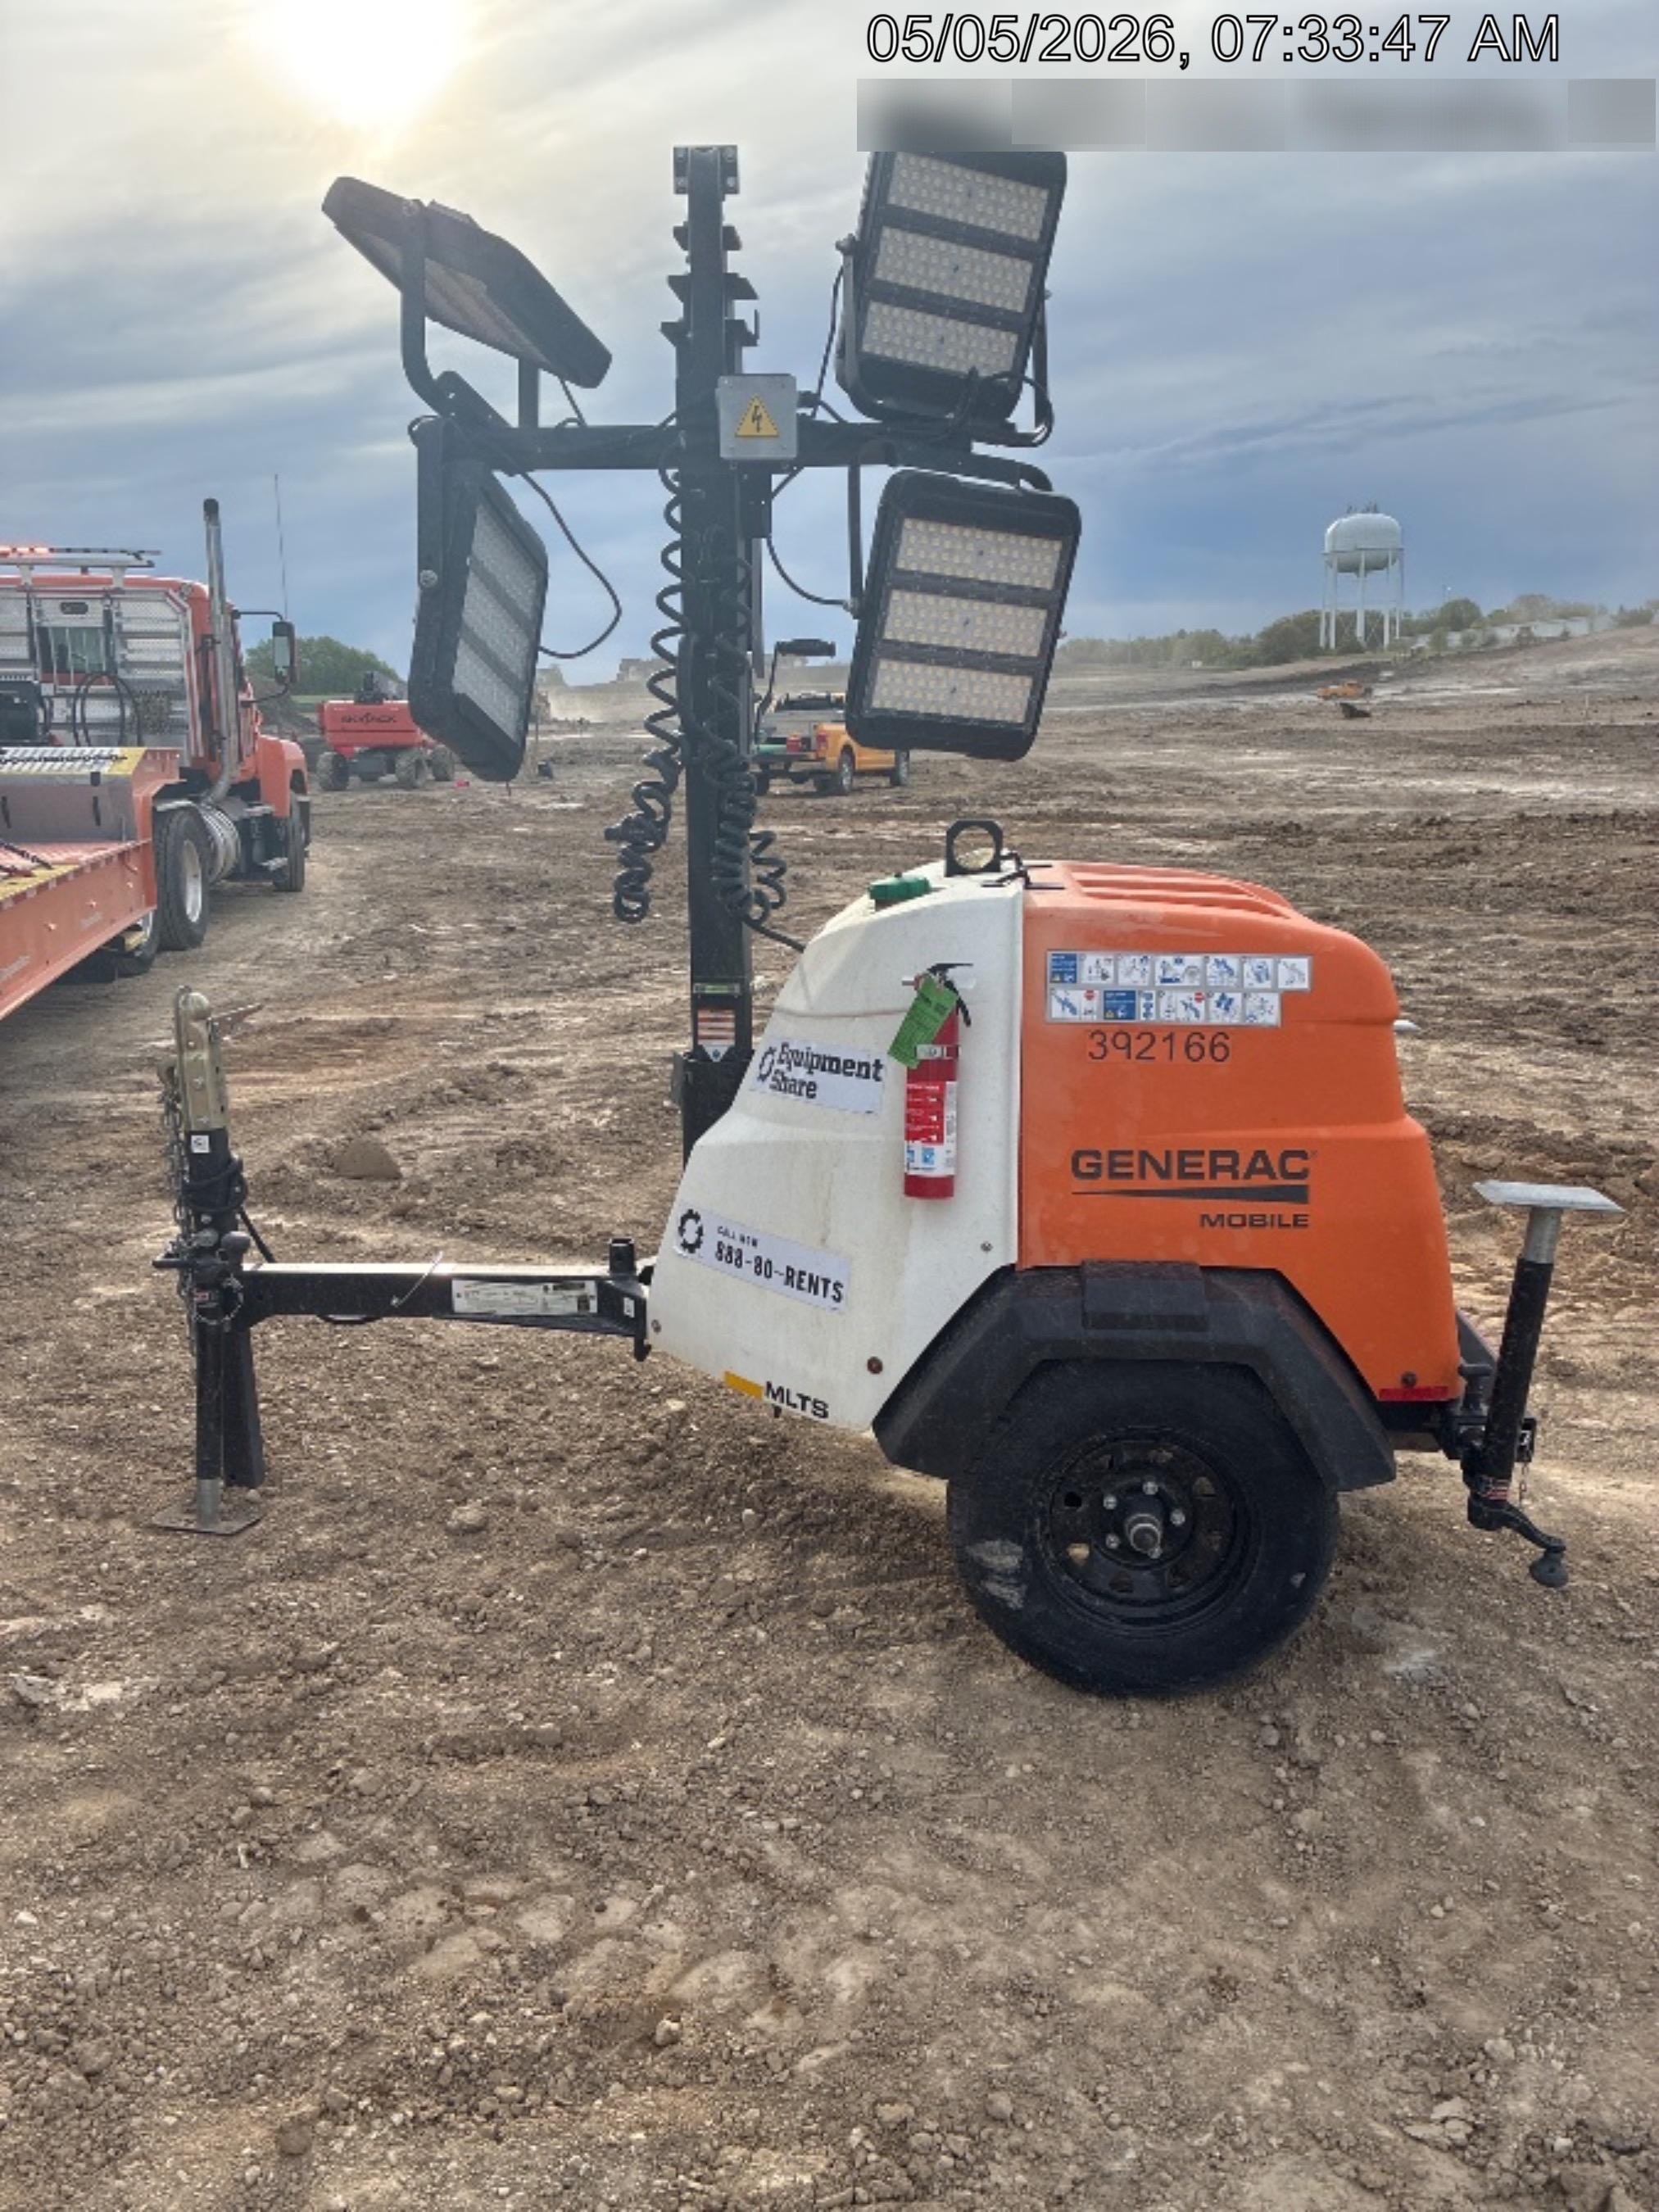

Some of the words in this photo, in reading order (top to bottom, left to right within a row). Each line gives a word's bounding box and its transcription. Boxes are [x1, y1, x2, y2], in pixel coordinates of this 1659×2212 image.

[777, 1041, 883, 1082] Equipment
[1088, 1030, 1231, 1062] 392166
[769, 1068, 818, 1099] Share
[1071, 1149, 1310, 1181] GENERAC
[1199, 1213, 1309, 1228] MOBILE
[715, 1240, 845, 1303] 888-80-RENTS
[765, 1381, 829, 1419] MLTS
